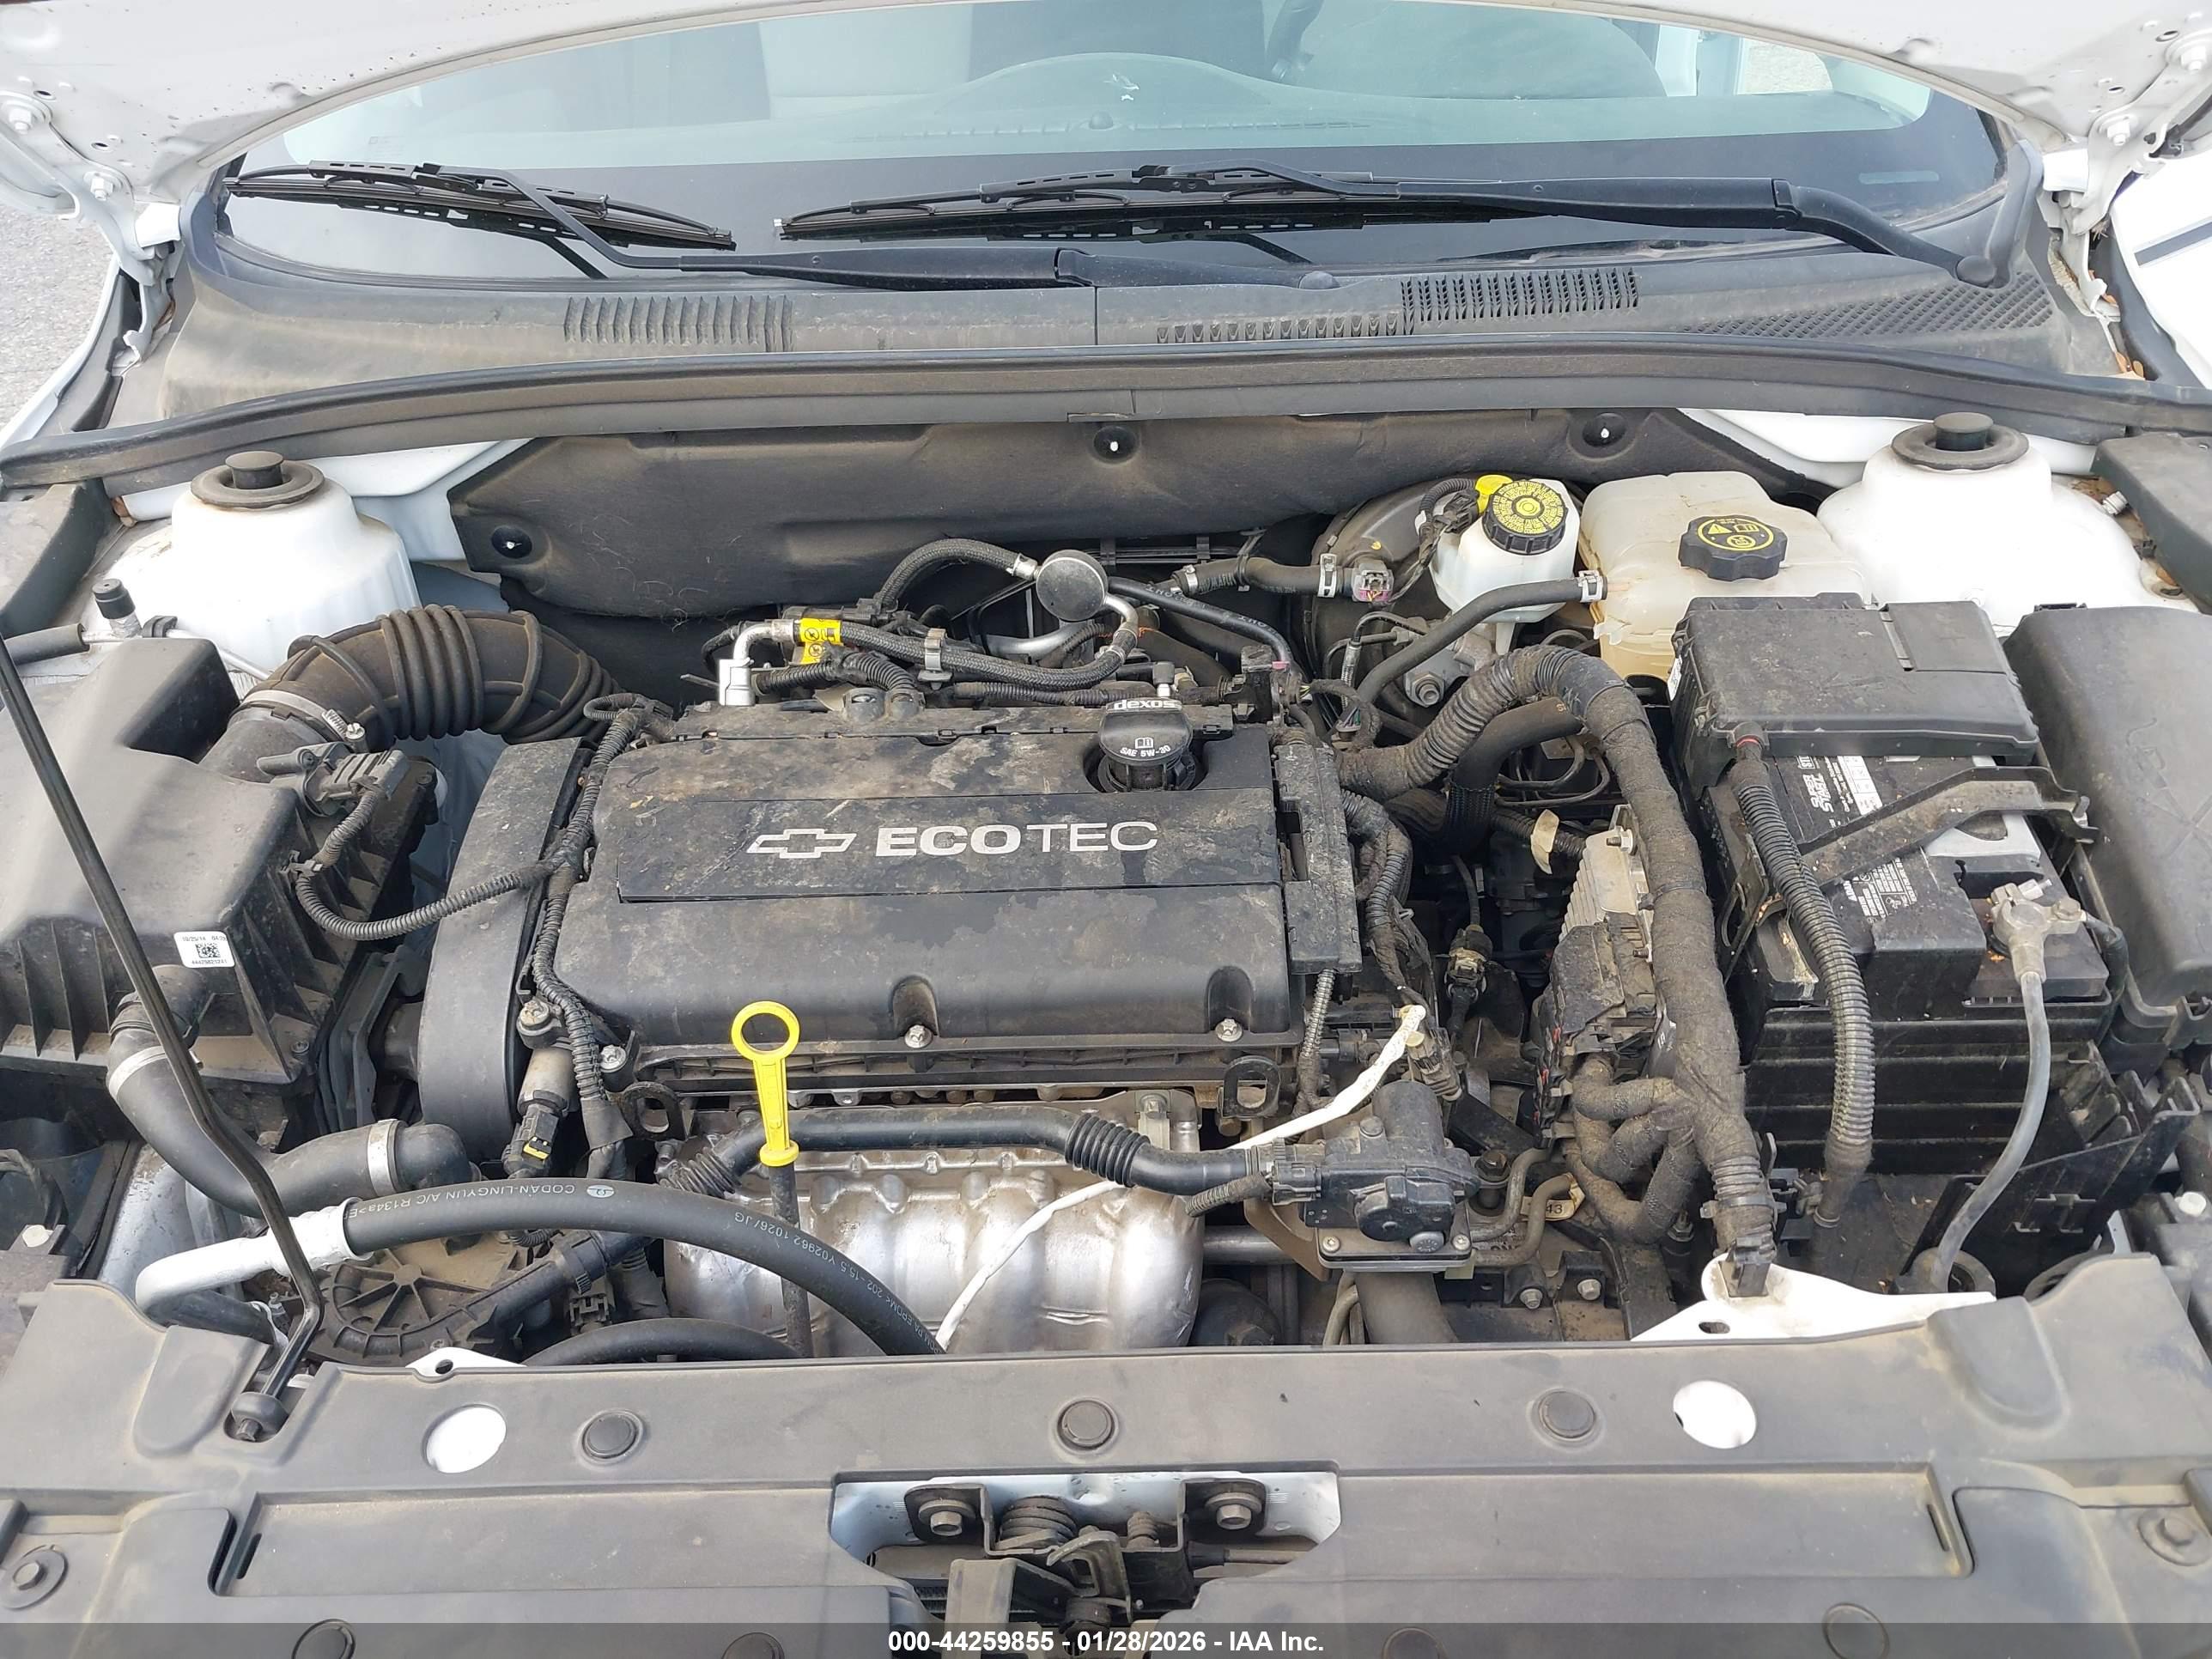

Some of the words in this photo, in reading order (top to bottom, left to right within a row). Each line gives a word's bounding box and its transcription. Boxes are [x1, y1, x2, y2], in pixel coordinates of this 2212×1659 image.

[1114, 699, 1176, 709] dexos
[1120, 746, 1138, 757] SAE
[1140, 744, 1171, 757] 5W-30
[1803, 774, 1821, 807] SUPER
[875, 821, 1158, 857] ECOTEC
[416, 1192, 439, 1205] A/C
[446, 1184, 575, 1200] CODAN-LINGYUN
